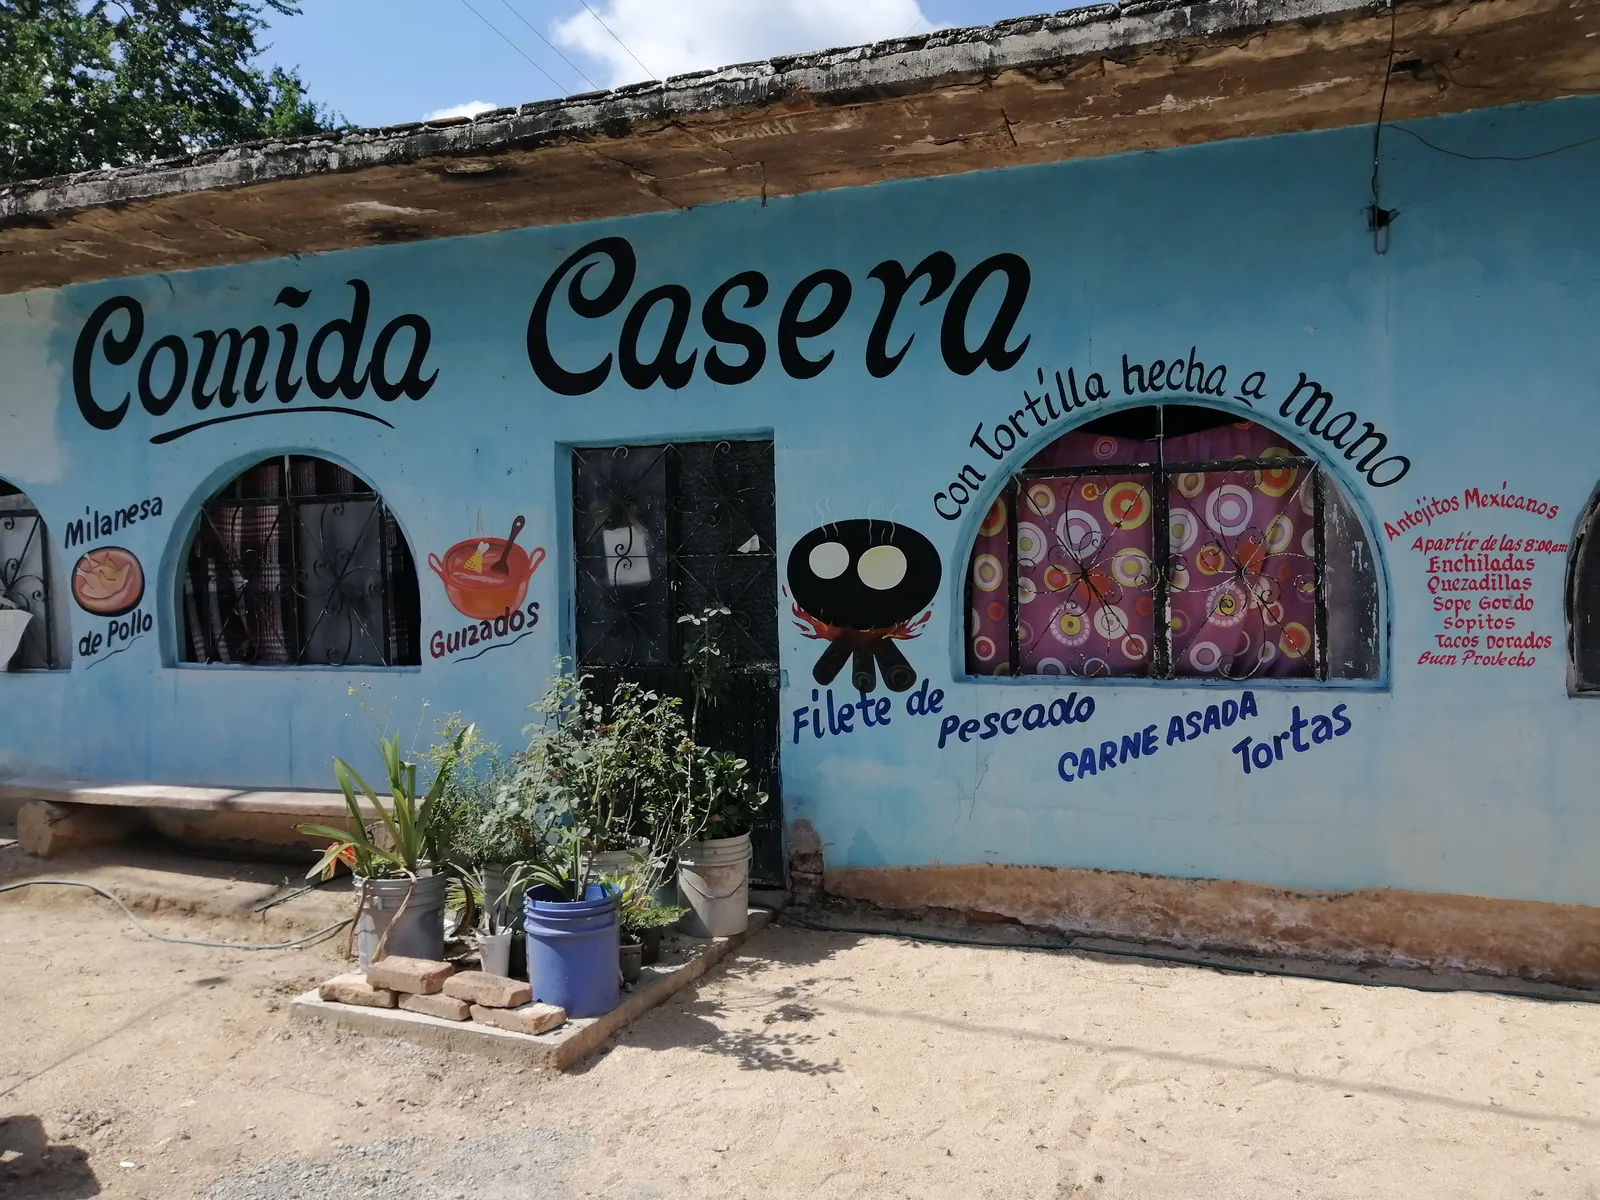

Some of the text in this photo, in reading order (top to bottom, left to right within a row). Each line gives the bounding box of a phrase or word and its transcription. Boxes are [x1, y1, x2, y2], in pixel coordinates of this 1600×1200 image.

[73, 237, 1031, 430] Comida Casera
[969, 367, 1111, 460] Tortilla
[1122, 345, 1227, 395] hecha
[1240, 371, 1267, 399] a
[65, 497, 162, 549] Milanesa
[1383, 495, 1459, 542] Antojitos
[1426, 553, 1535, 573] Enchiladas
[1480, 534, 1498, 551] de
[1500, 534, 1523, 551] las
[1427, 573, 1532, 594] Quezadillas
[1433, 593, 1534, 618] Sope Gordo
[79, 609, 152, 656] de Pollo
[430, 602, 539, 659] Guizados
[1434, 631, 1552, 649] Tacos Dorados
[1417, 650, 1535, 667] Buen Provecho
[793, 689, 891, 744] Filete
[906, 678, 944, 716] de
[1057, 691, 1258, 782] CARNE ASADA
[1232, 703, 1351, 774] Tortas
